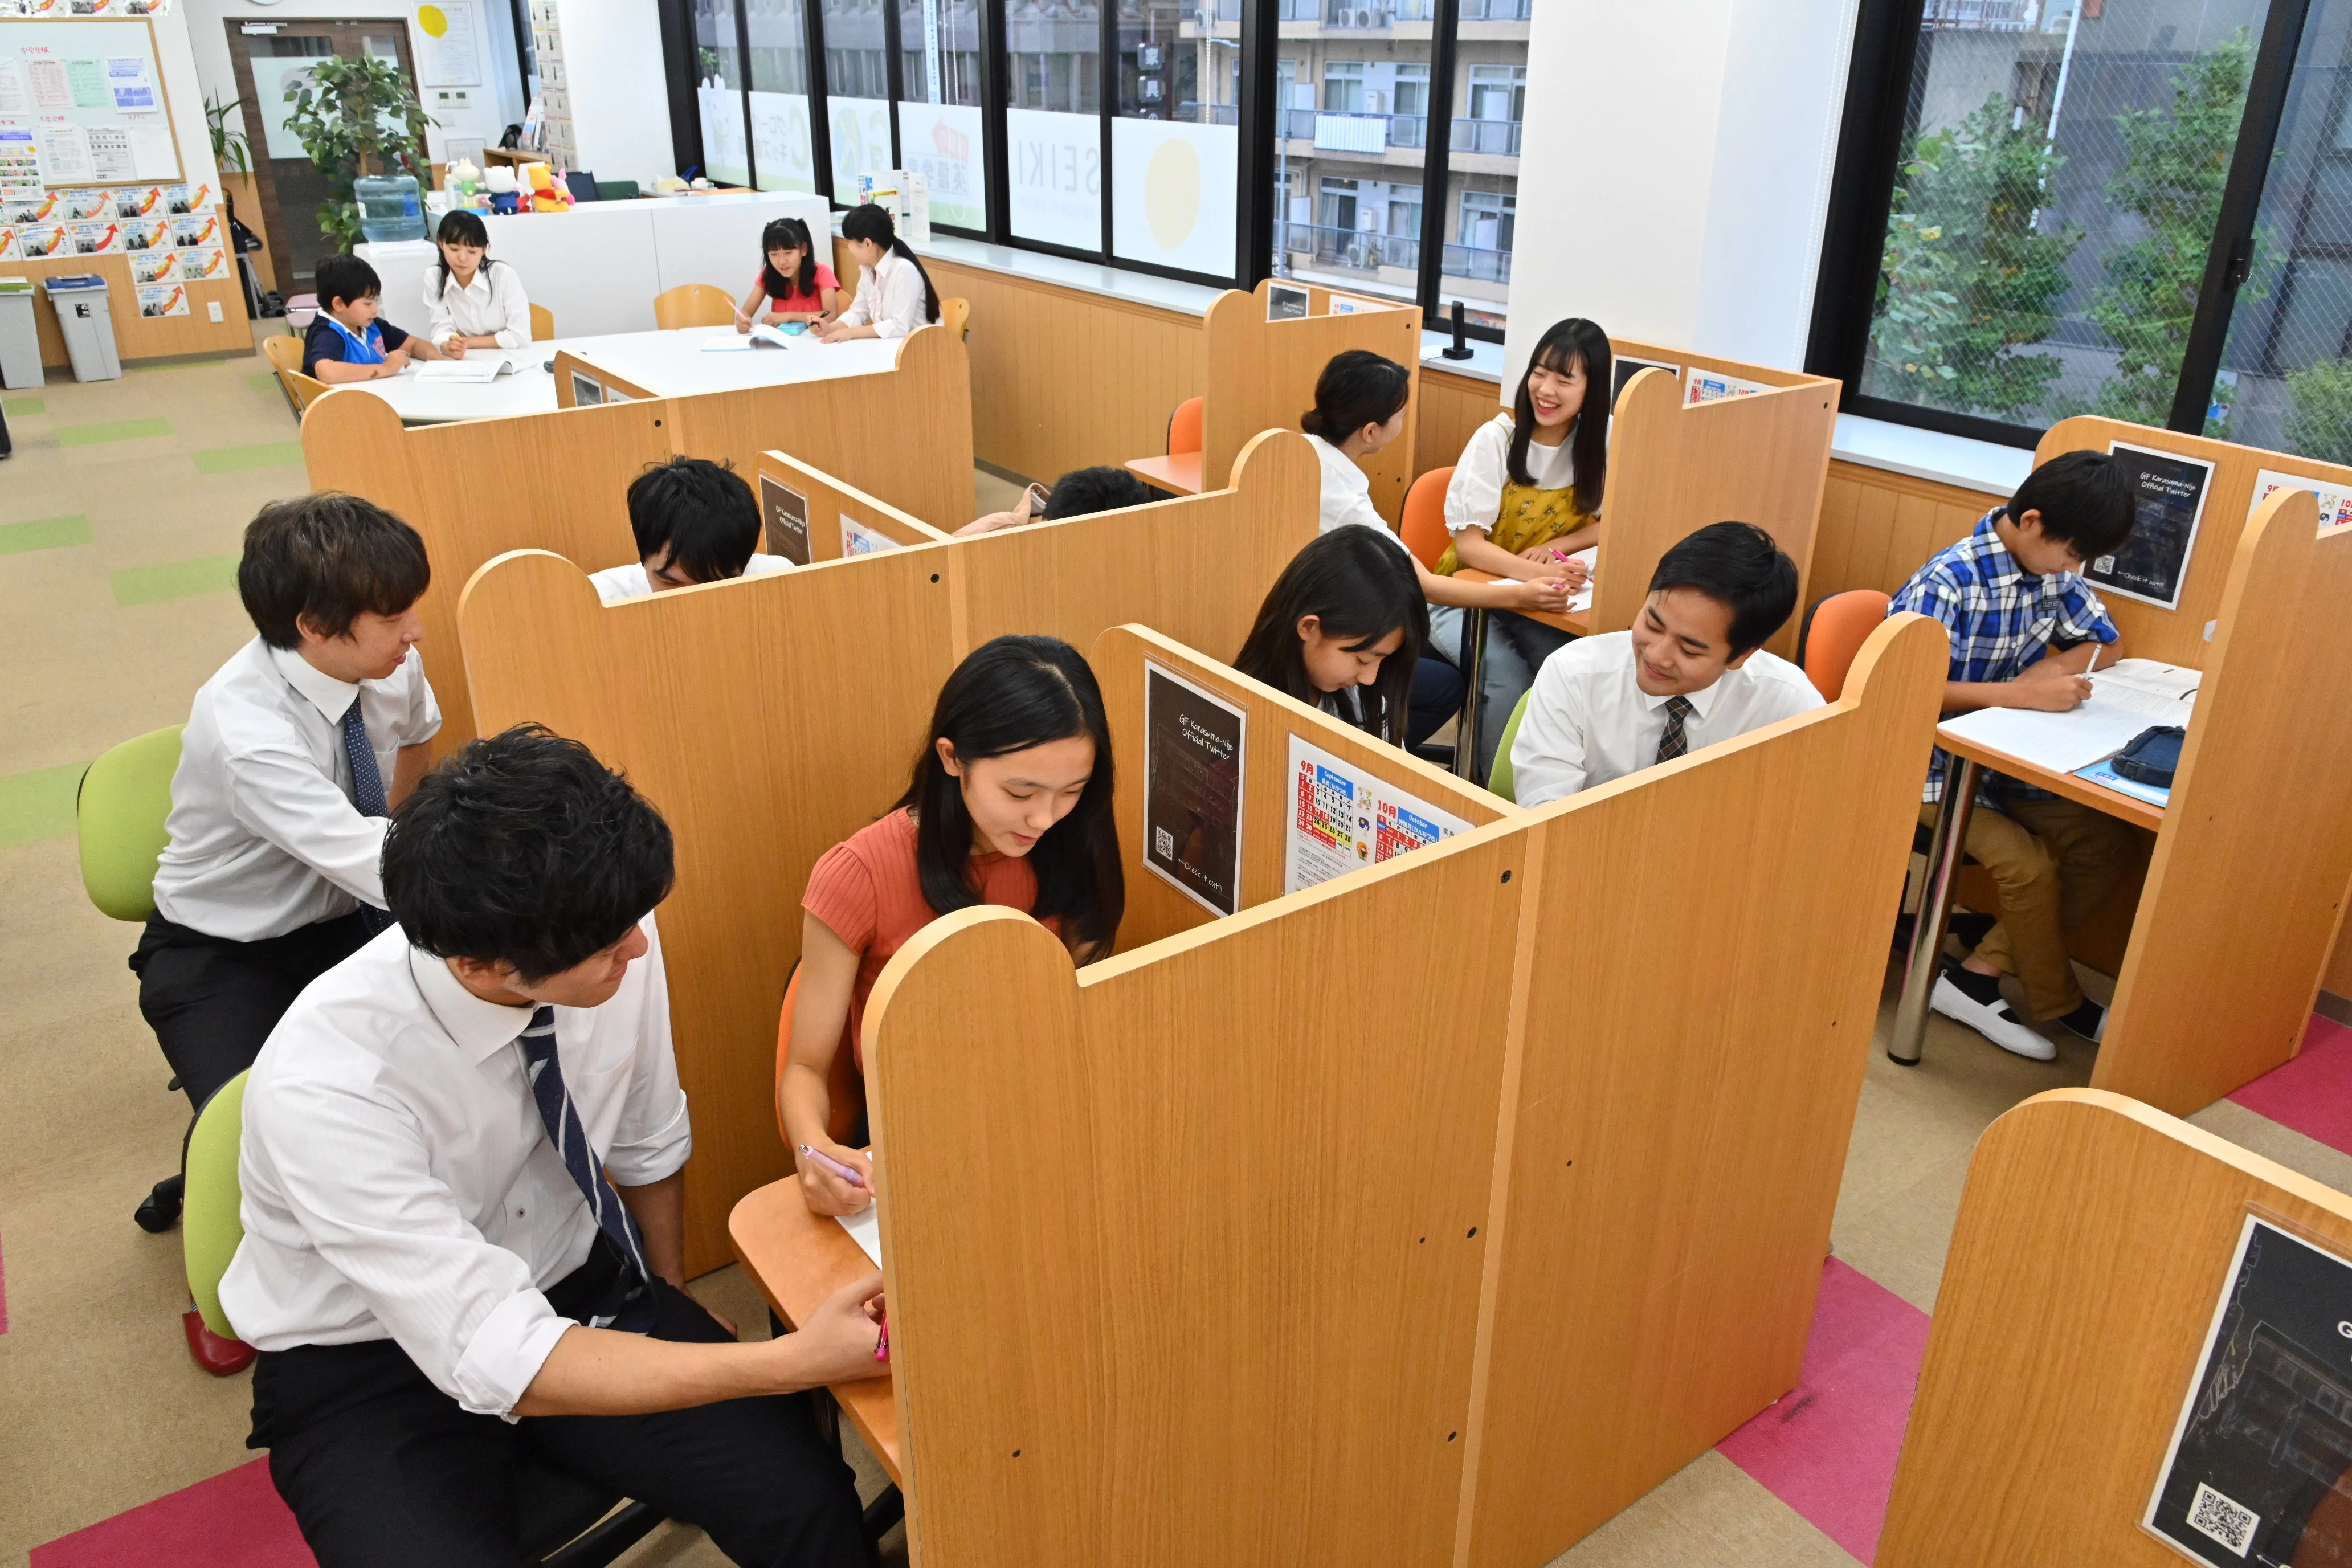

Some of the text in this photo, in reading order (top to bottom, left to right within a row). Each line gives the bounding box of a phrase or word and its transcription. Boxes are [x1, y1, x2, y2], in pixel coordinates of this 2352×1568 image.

[2141, 481, 2191, 498] Official Twitter
[2151, 475, 2196, 491] Karasuma-Nijo
[2124, 573, 2141, 582] Check
[1179, 714, 1233, 751] GF Karasuma-Nijo
[1182, 728, 1230, 761] Official Twitter
[1301, 760, 1313, 775] 9月
[1324, 770, 1346, 786] September
[1378, 799, 1396, 819] 10月
[1408, 815, 1428, 828] October
[1378, 842, 1384, 851] 13
[1386, 847, 1392, 856] 14
[1185, 861, 1223, 893] Check it out!!!
